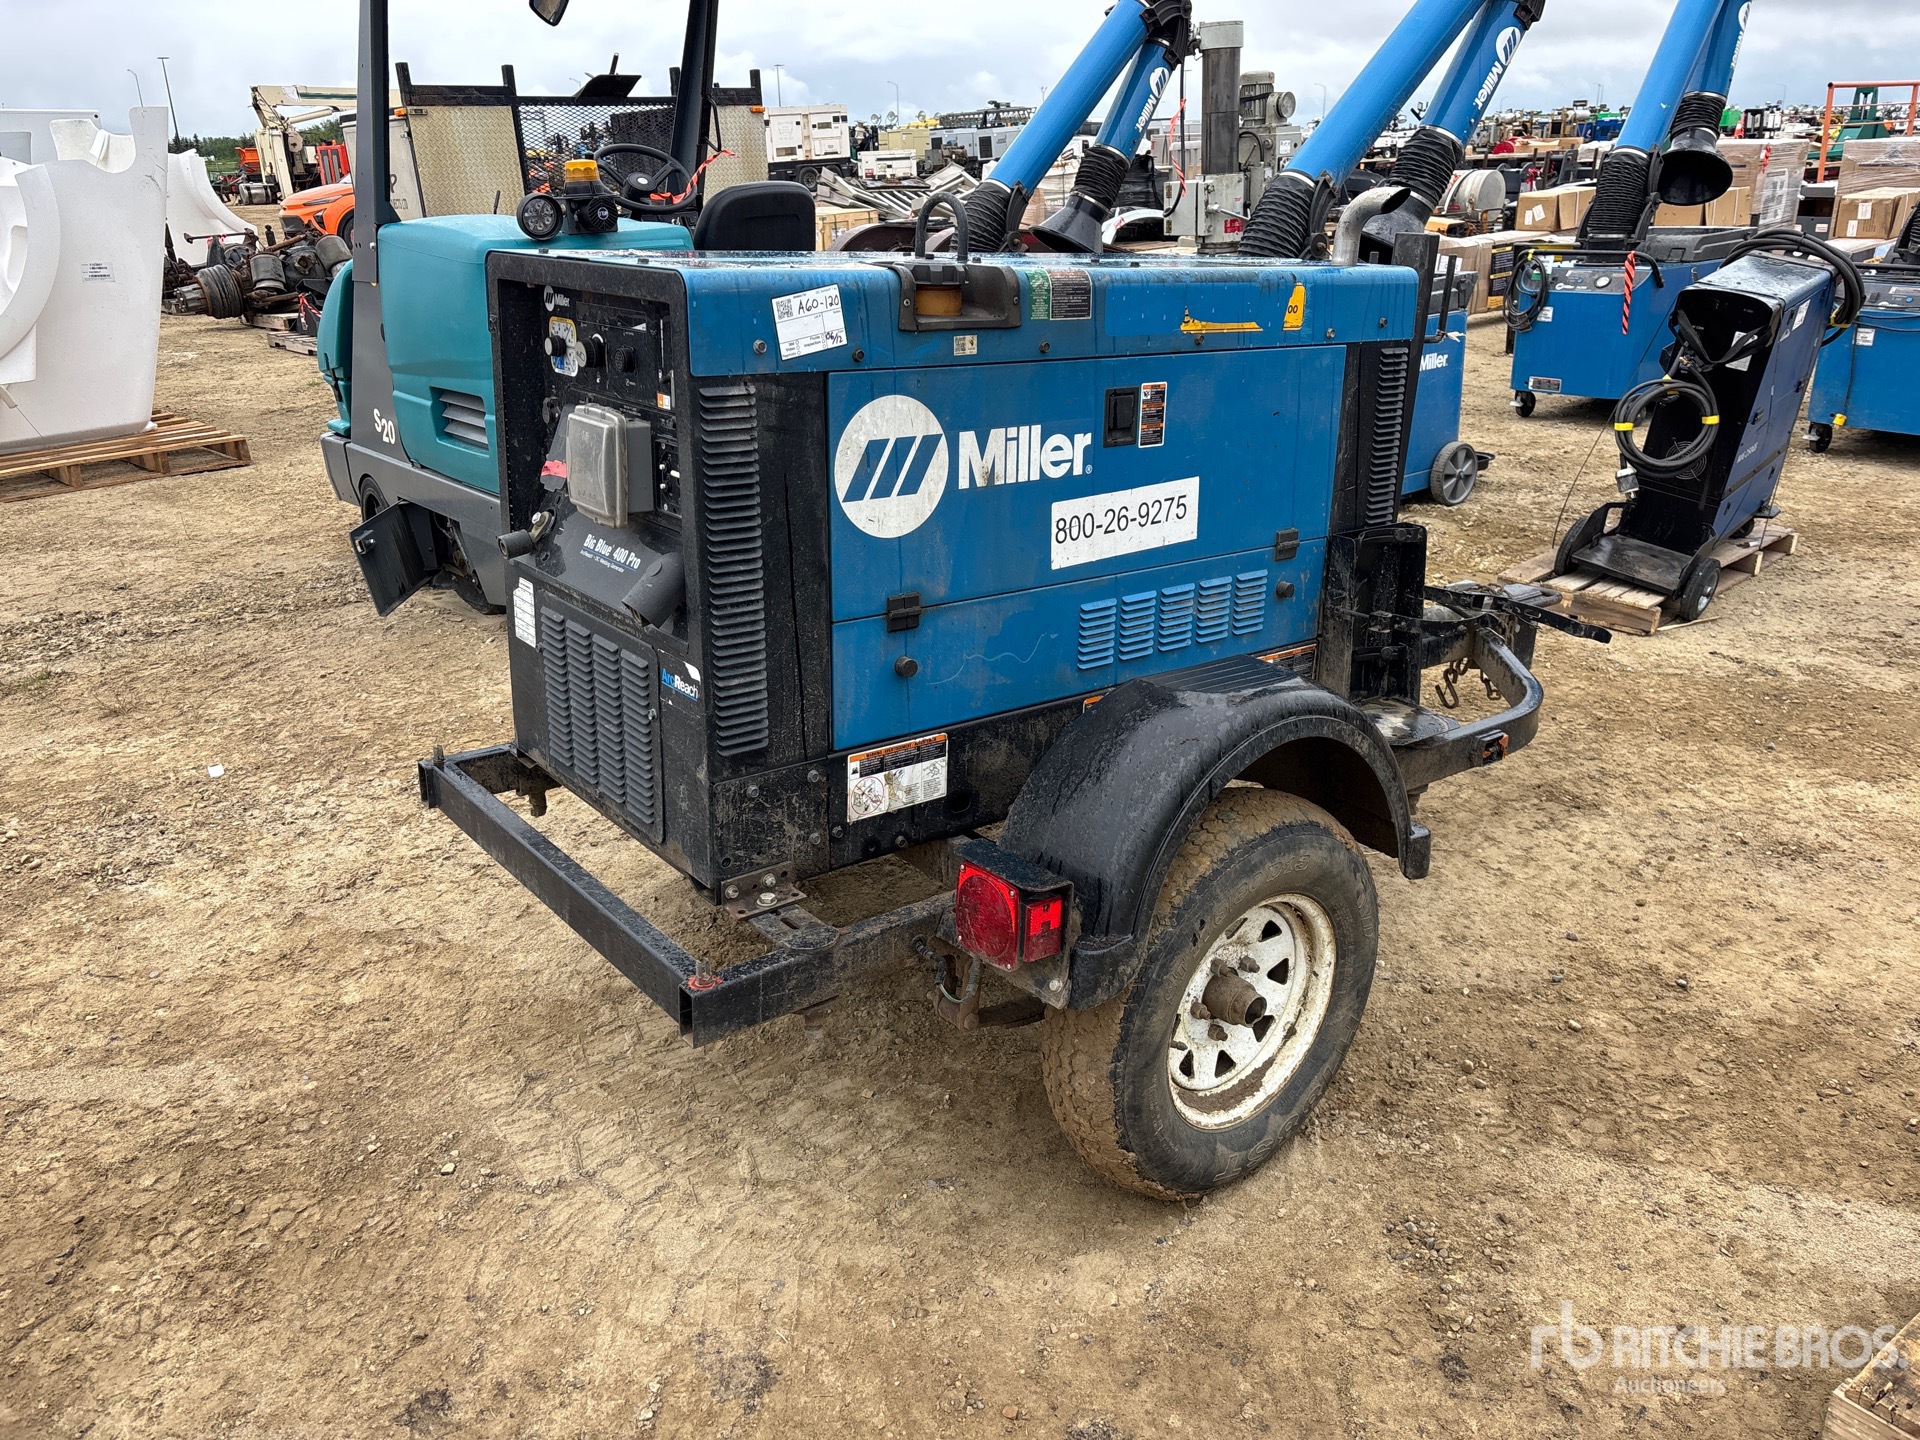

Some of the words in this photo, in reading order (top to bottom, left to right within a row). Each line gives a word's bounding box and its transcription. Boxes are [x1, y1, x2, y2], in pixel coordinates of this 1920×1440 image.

[1474, 61, 1503, 110] Miller
[1136, 94, 1157, 132] Miller
[554, 293, 570, 307] Miller
[798, 294, 840, 315] A60-120
[1420, 352, 1448, 371] Miller
[958, 424, 1092, 490] Miller
[1055, 494, 1188, 544] 800-26-9275
[594, 538, 613, 557] Blue
[612, 546, 629, 564] 400
[625, 551, 641, 569] Pro
[661, 668, 699, 699] ArcReach
